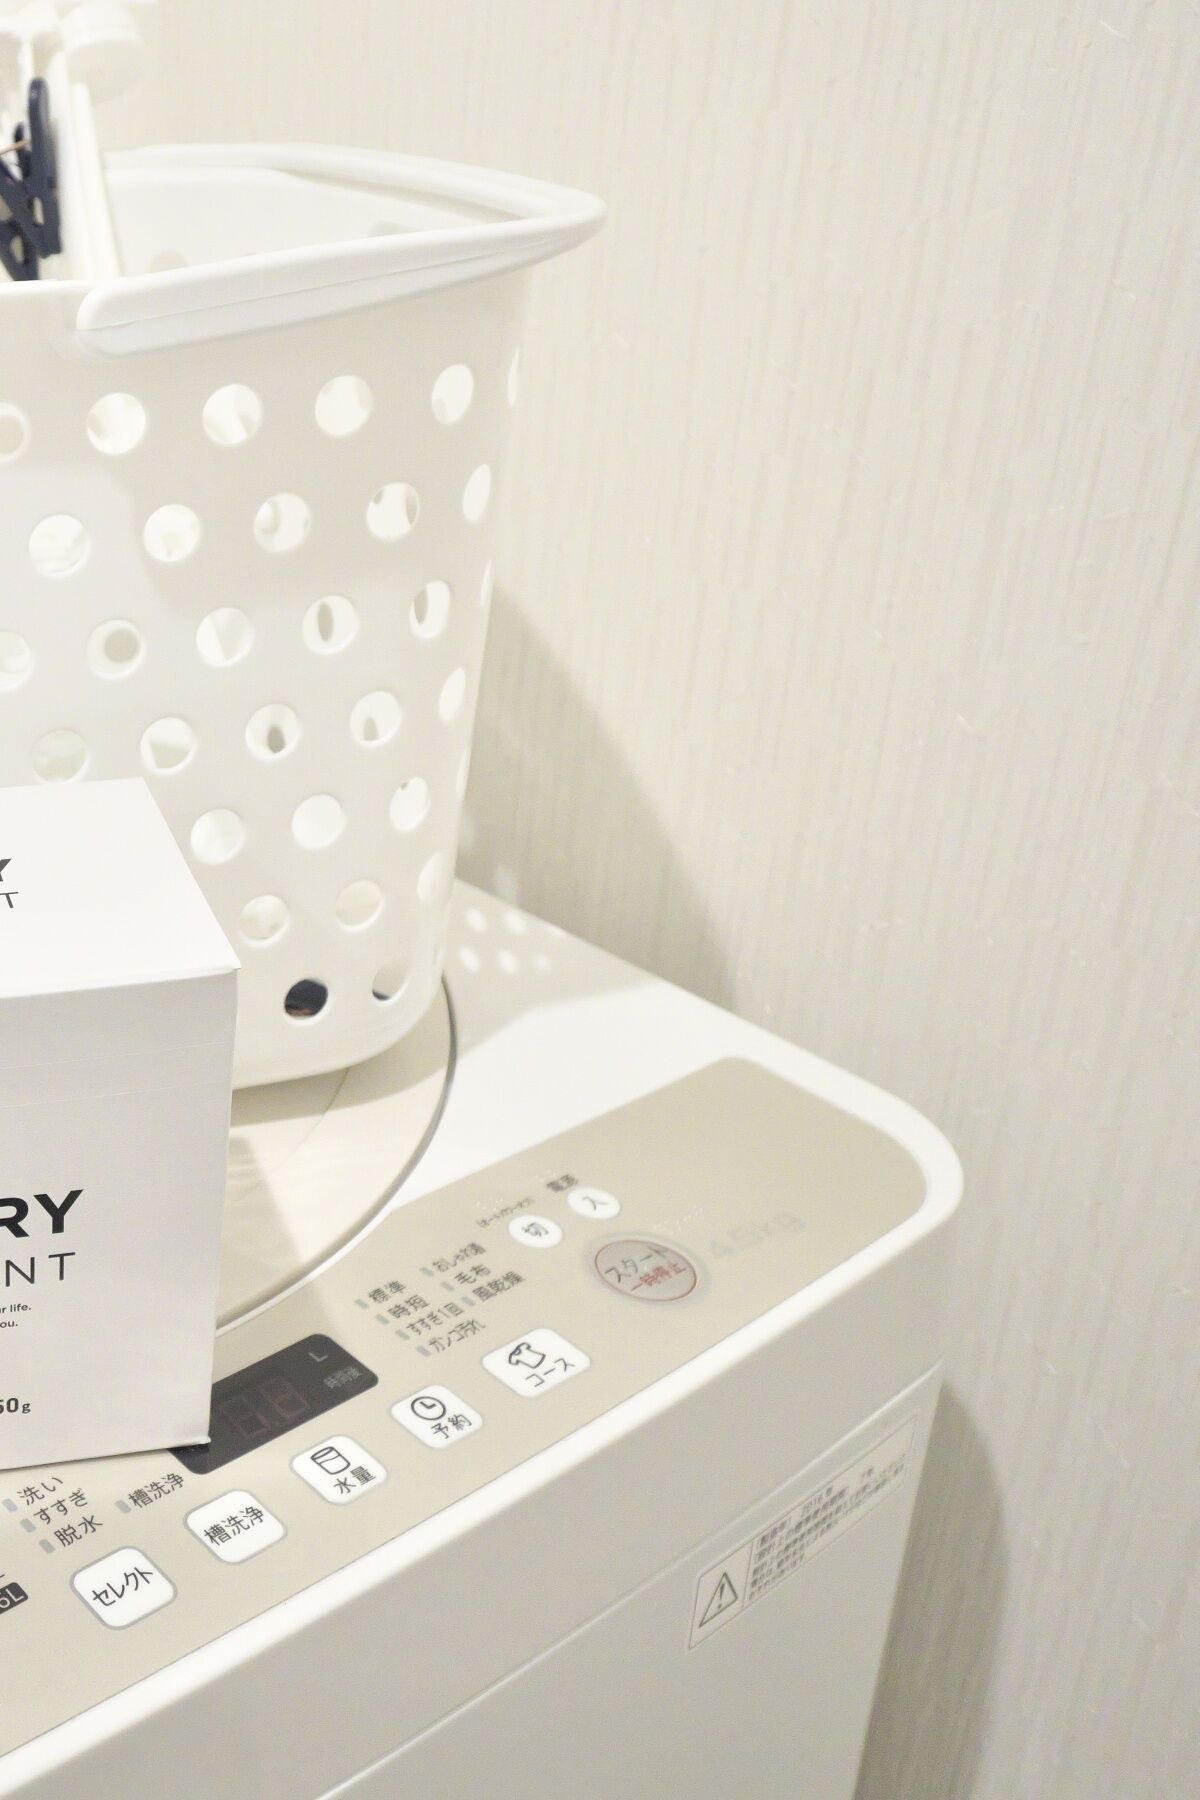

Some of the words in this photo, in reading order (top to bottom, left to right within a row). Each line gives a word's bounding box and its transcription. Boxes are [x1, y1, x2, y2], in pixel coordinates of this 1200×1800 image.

[581, 1196, 608, 1210] 入
[522, 1222, 549, 1237] 切
[455, 1264, 492, 1285] 毛布
[604, 1246, 669, 1283] スタート
[368, 1280, 407, 1304] 標準
[387, 1294, 429, 1319] 時短
[10, 1302, 32, 1313] life.
[525, 1357, 576, 1388] コース
[430, 1413, 473, 1441] 予約
[17, 1476, 65, 1506] 洗い
[127, 1472, 185, 1509] 槽洗浄
[333, 1465, 377, 1496] 水量
[32, 1487, 90, 1525] すすぎ
[54, 1514, 104, 1548] 脱水
[204, 1506, 265, 1547] 槽洗浄
[91, 1566, 155, 1608] セレクト
